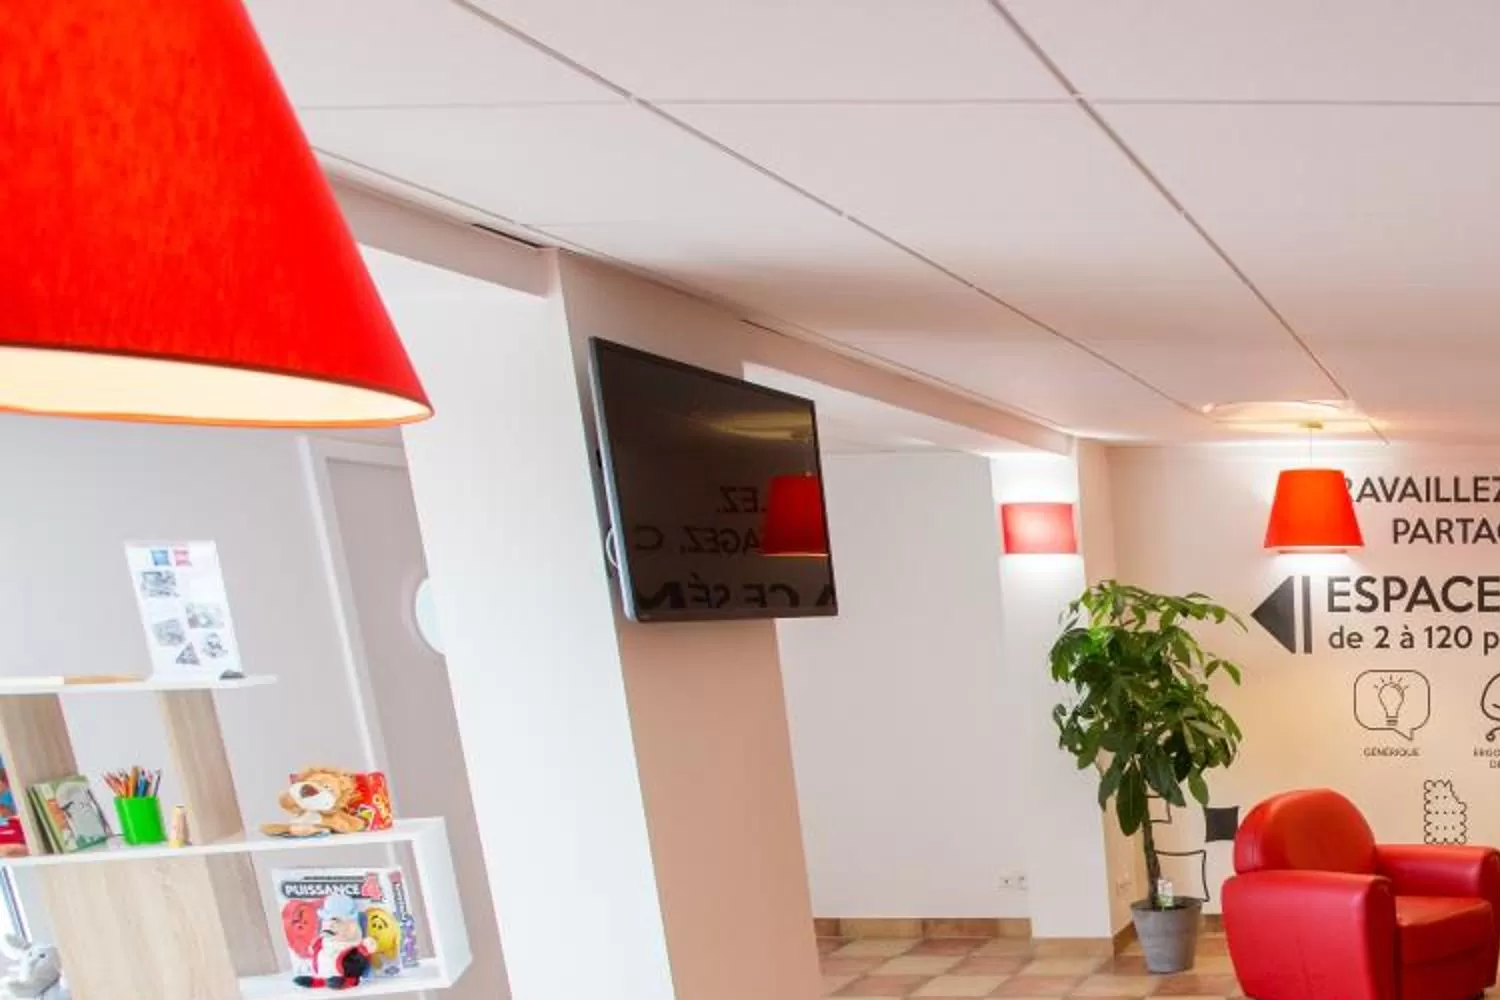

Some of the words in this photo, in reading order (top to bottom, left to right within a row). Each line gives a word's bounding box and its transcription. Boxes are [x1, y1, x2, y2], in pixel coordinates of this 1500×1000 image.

[1327, 575, 1500, 613] ESPACE
[1328, 625, 1364, 649] de
[1374, 625, 1391, 649] 2
[1400, 624, 1415, 649] à
[1424, 625, 1473, 649] 120
[284, 882, 361, 896] PUISSANCE
